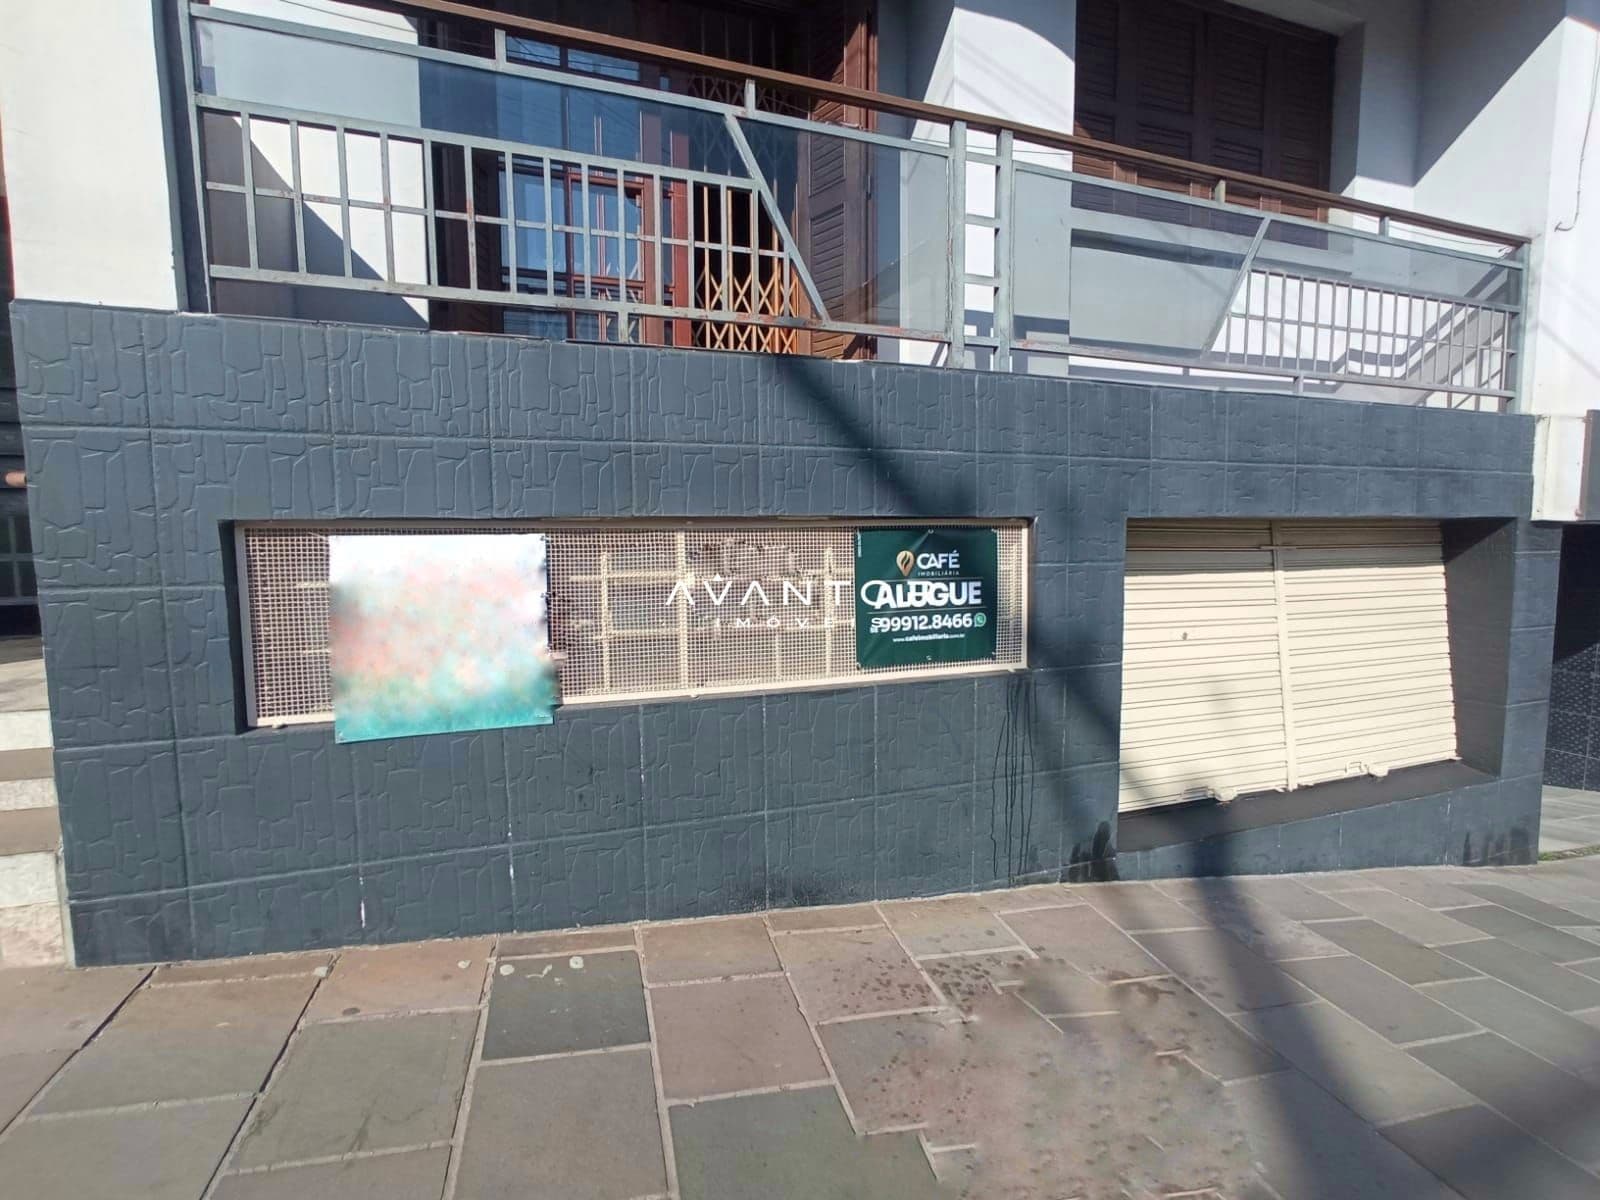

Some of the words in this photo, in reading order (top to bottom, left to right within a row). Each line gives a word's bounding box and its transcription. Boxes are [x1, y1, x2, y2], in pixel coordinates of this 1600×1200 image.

[916, 550, 960, 570] CAFÉ
[917, 569, 960, 577] IMOBILIÁRIA
[873, 580, 982, 609] ALUGUE
